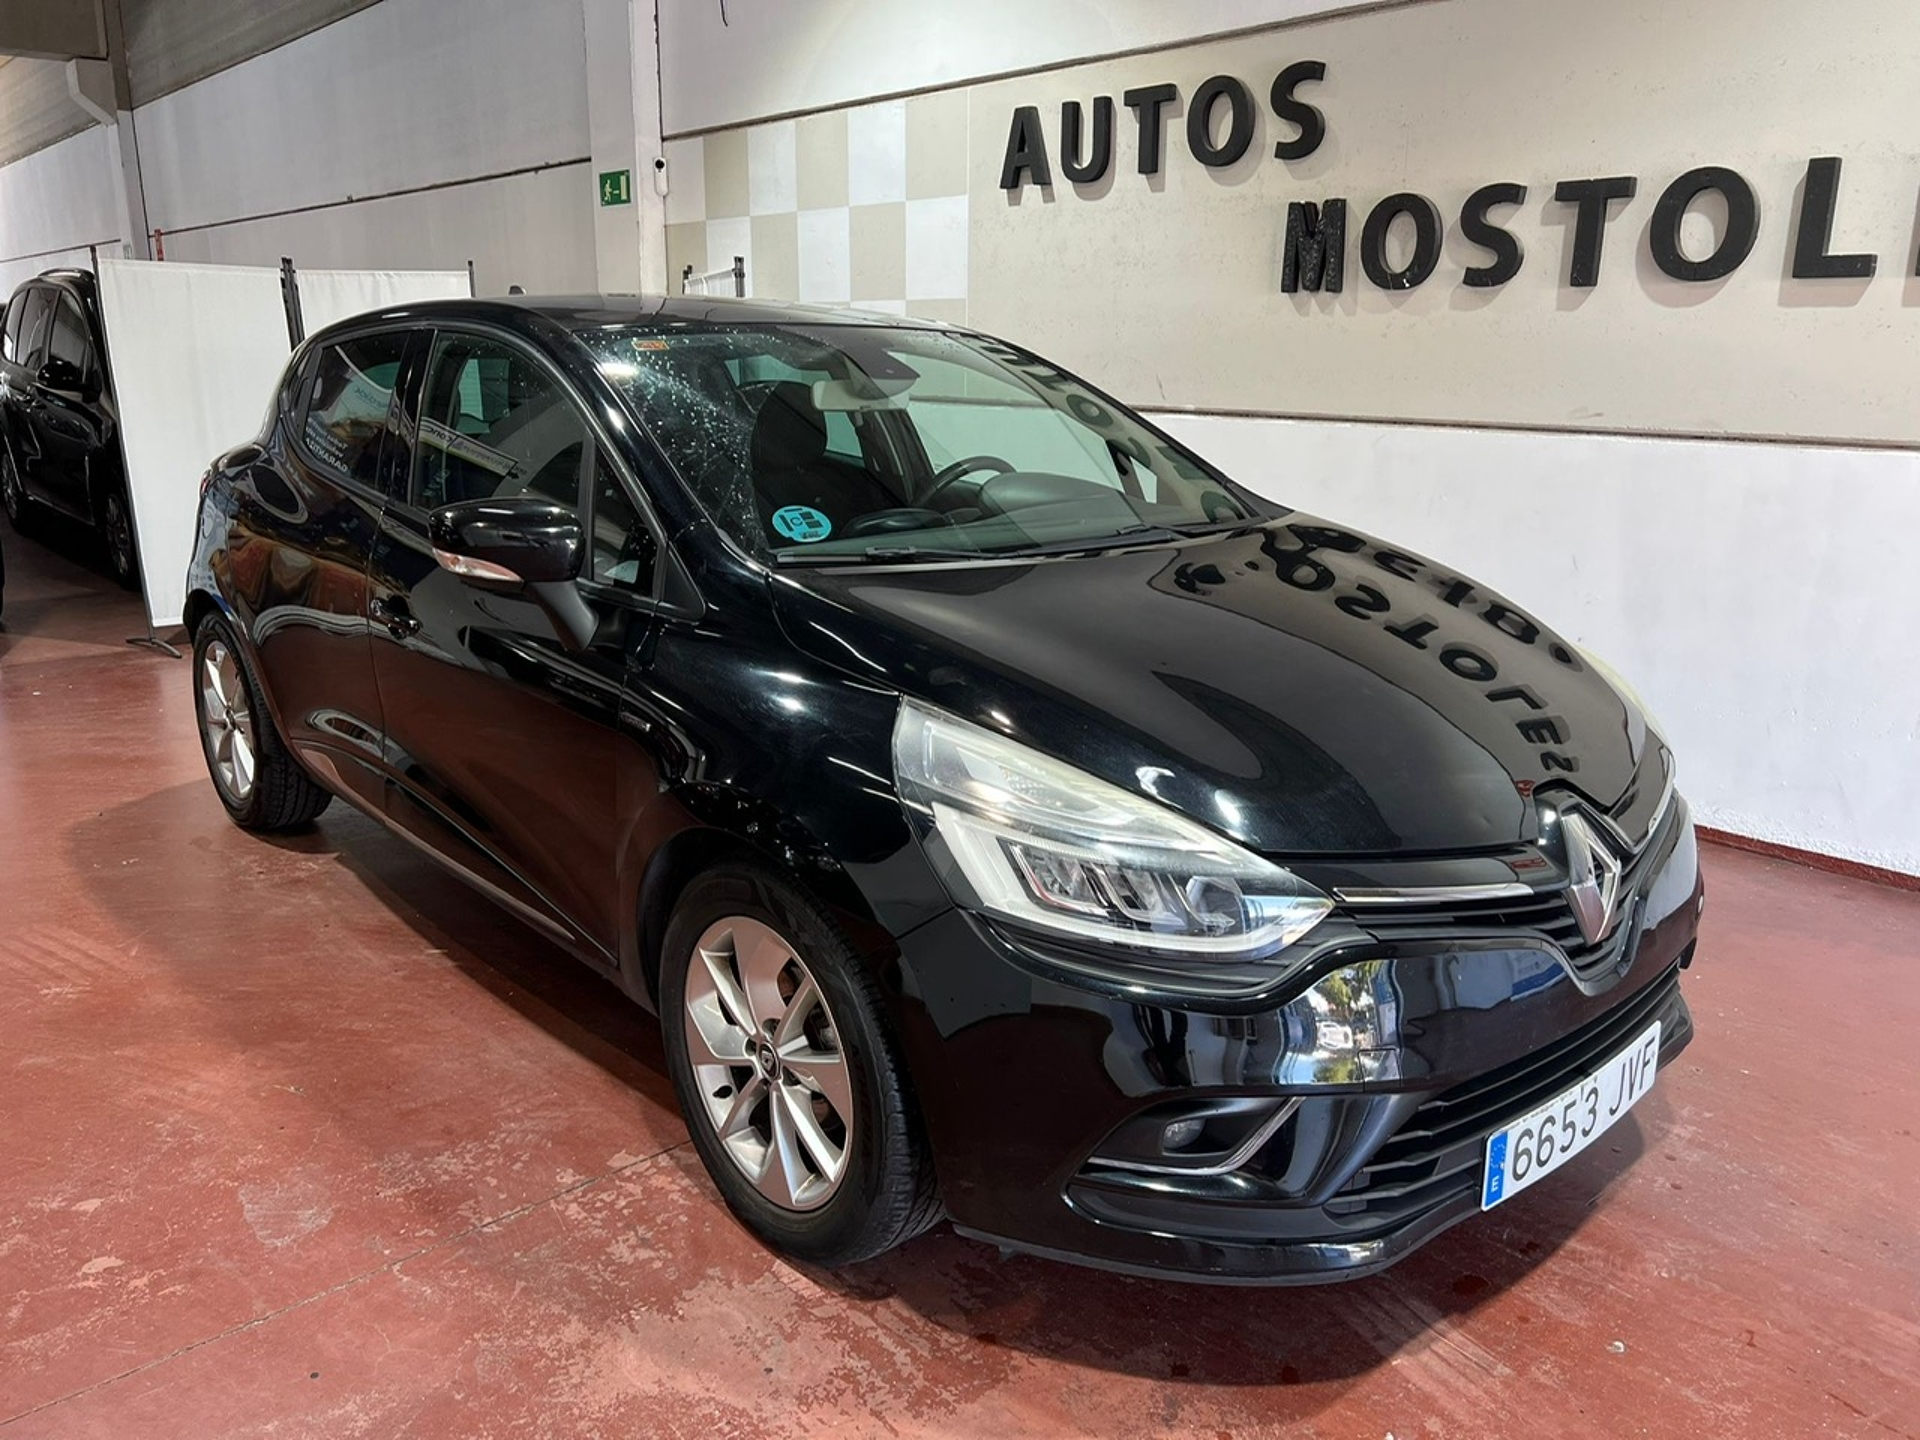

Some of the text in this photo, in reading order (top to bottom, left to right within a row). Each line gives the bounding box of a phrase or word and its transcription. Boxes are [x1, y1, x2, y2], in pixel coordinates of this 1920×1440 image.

[1000, 61, 1327, 190] AUTOS
[1281, 157, 1920, 293] MOSTOL
[1511, 1036, 1656, 1182] 6653 JVF
[1490, 1175, 1500, 1192] E
